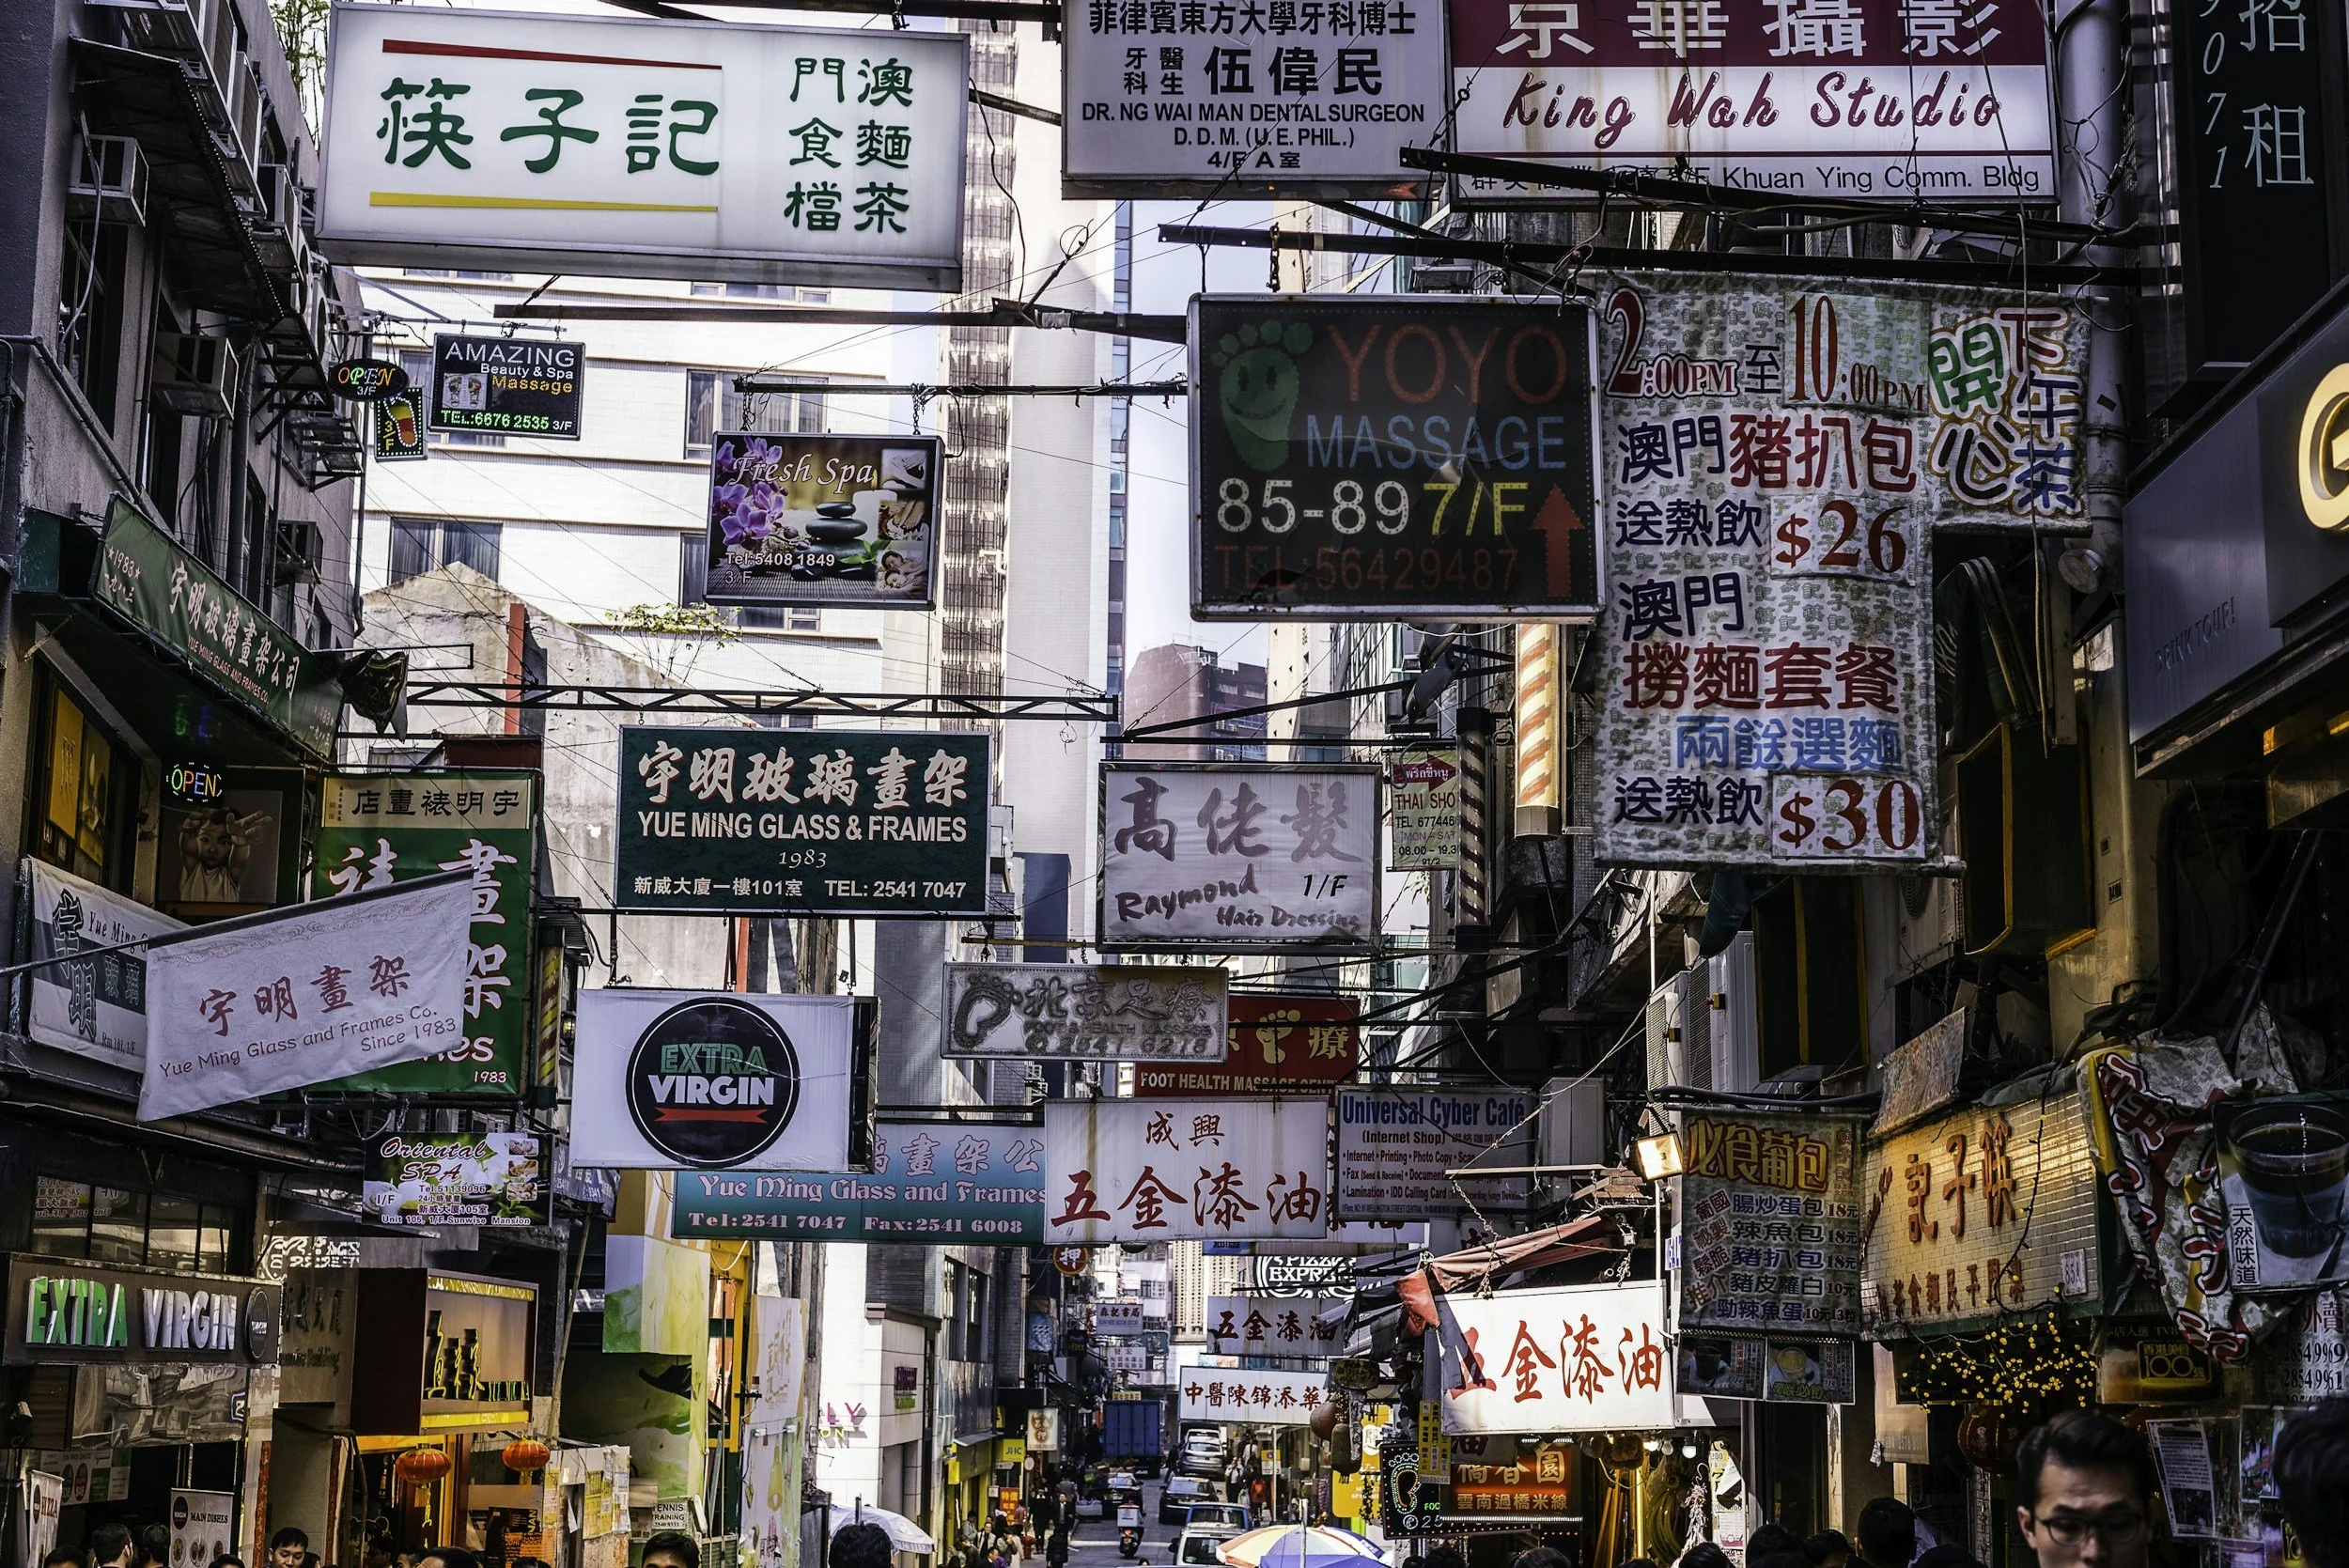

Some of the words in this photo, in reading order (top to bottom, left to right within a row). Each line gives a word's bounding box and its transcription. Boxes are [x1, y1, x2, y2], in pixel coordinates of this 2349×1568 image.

[1204, 46, 1382, 96] 伍偉民
[1082, 103, 1115, 121] DR.
[1120, 103, 1148, 121] NG
[1155, 103, 1191, 121] WAI
[1199, 103, 1243, 122] MAN
[1503, 71, 1635, 149] King
[1668, 70, 1779, 129] Wah
[1810, 70, 2001, 129] Studio
[377, 77, 720, 177] 筷子記
[1724, 165, 1807, 190] Khuan
[1816, 166, 1872, 196] Ying
[1884, 167, 1971, 191] Comm.
[1983, 166, 2040, 196] Bldg
[445, 342, 574, 367] AMAZING
[1327, 323, 1568, 404] YOYO
[337, 367, 396, 386] OPEN
[481, 364, 528, 379] Beauty
[533, 366, 543, 377] &
[547, 367, 573, 380] Spa
[492, 376, 573, 395] Massage
[357, 386, 376, 396] 3/F
[514, 415, 549, 430] 2535
[552, 420, 573, 431] 3/F
[1307, 414, 1567, 470] MASSAGE
[728, 454, 812, 486] Fresh
[817, 458, 876, 494] Spa
[1217, 477, 1409, 535] 85-89
[1423, 481, 1529, 536] 7/F
[1616, 499, 1762, 548] 送熱飲
[1776, 499, 1908, 573] $26
[797, 554, 835, 566] 1849
[1619, 572, 1745, 641] 澳門
[213, 656, 229, 676] GLASS
[241, 676, 260, 703] FRAMES
[1622, 642, 1899, 712] 撈麵套餐
[171, 768, 217, 798] OPEN
[638, 740, 969, 811] 宇明玻璃畫架
[1395, 794, 1423, 810] THAI
[1614, 776, 1763, 826] 送熱飲
[1778, 780, 1920, 850] $30
[638, 811, 686, 838] YUE
[692, 812, 753, 838] MING
[759, 814, 840, 840] GLASS
[846, 815, 862, 840] &
[868, 815, 967, 843] FRAMES
[1395, 816, 1412, 828] TEL
[1404, 832, 1426, 841] MON
[1438, 831, 1456, 840] SAT
[779, 849, 827, 869] 1983
[825, 880, 868, 896] TEL:
[874, 880, 917, 898] 2541
[923, 881, 966, 898] 7047
[1115, 862, 1260, 923] Raymond
[1303, 874, 1348, 899] 1/F
[89, 911, 107, 938] Yue
[1217, 904, 1265, 927] Hair
[1271, 905, 1361, 933] Dressing
[199, 955, 411, 1037] 宇明畫架
[101, 1032, 113, 1048] Rm
[160, 1061, 193, 1079] Yue
[198, 1050, 241, 1070] Ming
[247, 1038, 297, 1058] Glass
[303, 1025, 334, 1046] and
[340, 1012, 403, 1037] Frames
[411, 1006, 437, 1020] Co.
[360, 1032, 406, 1052] Since
[413, 1017, 457, 1040] 1983
[661, 1043, 769, 1075] EXTRA
[474, 1071, 506, 1083] 1983
[648, 1075, 774, 1105] VIRGIN
[1141, 1072, 1175, 1088] FOOT
[1179, 1073, 1230, 1090] HEALTH
[1343, 1095, 1424, 1125] Universal
[1430, 1096, 1480, 1127] Cyber
[1486, 1096, 1524, 1126] Café
[1145, 1110, 1225, 1151] 成興
[1362, 1130, 1410, 1143] (Internet
[1413, 1131, 1445, 1145] Shop)
[381, 1136, 487, 1159] Oriental
[1346, 1150, 1375, 1162] Internet
[1380, 1151, 1408, 1165] Printing
[1413, 1151, 1434, 1163] Photo
[1435, 1152, 1452, 1166] Copy
[400, 1161, 463, 1182] SPA
[1346, 1168, 1359, 1180] Fax
[699, 1175, 748, 1198] Yue
[755, 1176, 822, 1203] Ming
[831, 1178, 896, 1201] Glass
[905, 1181, 948, 1202] and
[957, 1181, 1045, 1203] Frames
[1050, 1161, 1322, 1231] 五金漆油
[1346, 1186, 1385, 1198] Lamination
[1405, 1186, 1428, 1202] Calling
[1430, 1187, 1447, 1200] Card
[381, 1216, 402, 1224] Unit
[448, 1217, 488, 1225] Sunwise
[797, 1215, 847, 1230] 7047
[971, 1219, 1023, 1234] 6008
[1060, 1247, 1080, 1267] 押
[2232, 1206, 2257, 1285] 天然味道
[26, 1277, 128, 1347] EXTRA
[141, 1287, 237, 1351] VIRGIN
[1451, 1313, 1662, 1405] 五金漆油
[1457, 1493, 1568, 1511] 雲南過橋米線
[191, 1513, 206, 1522] MAIN
[208, 1514, 228, 1524] DISHES
